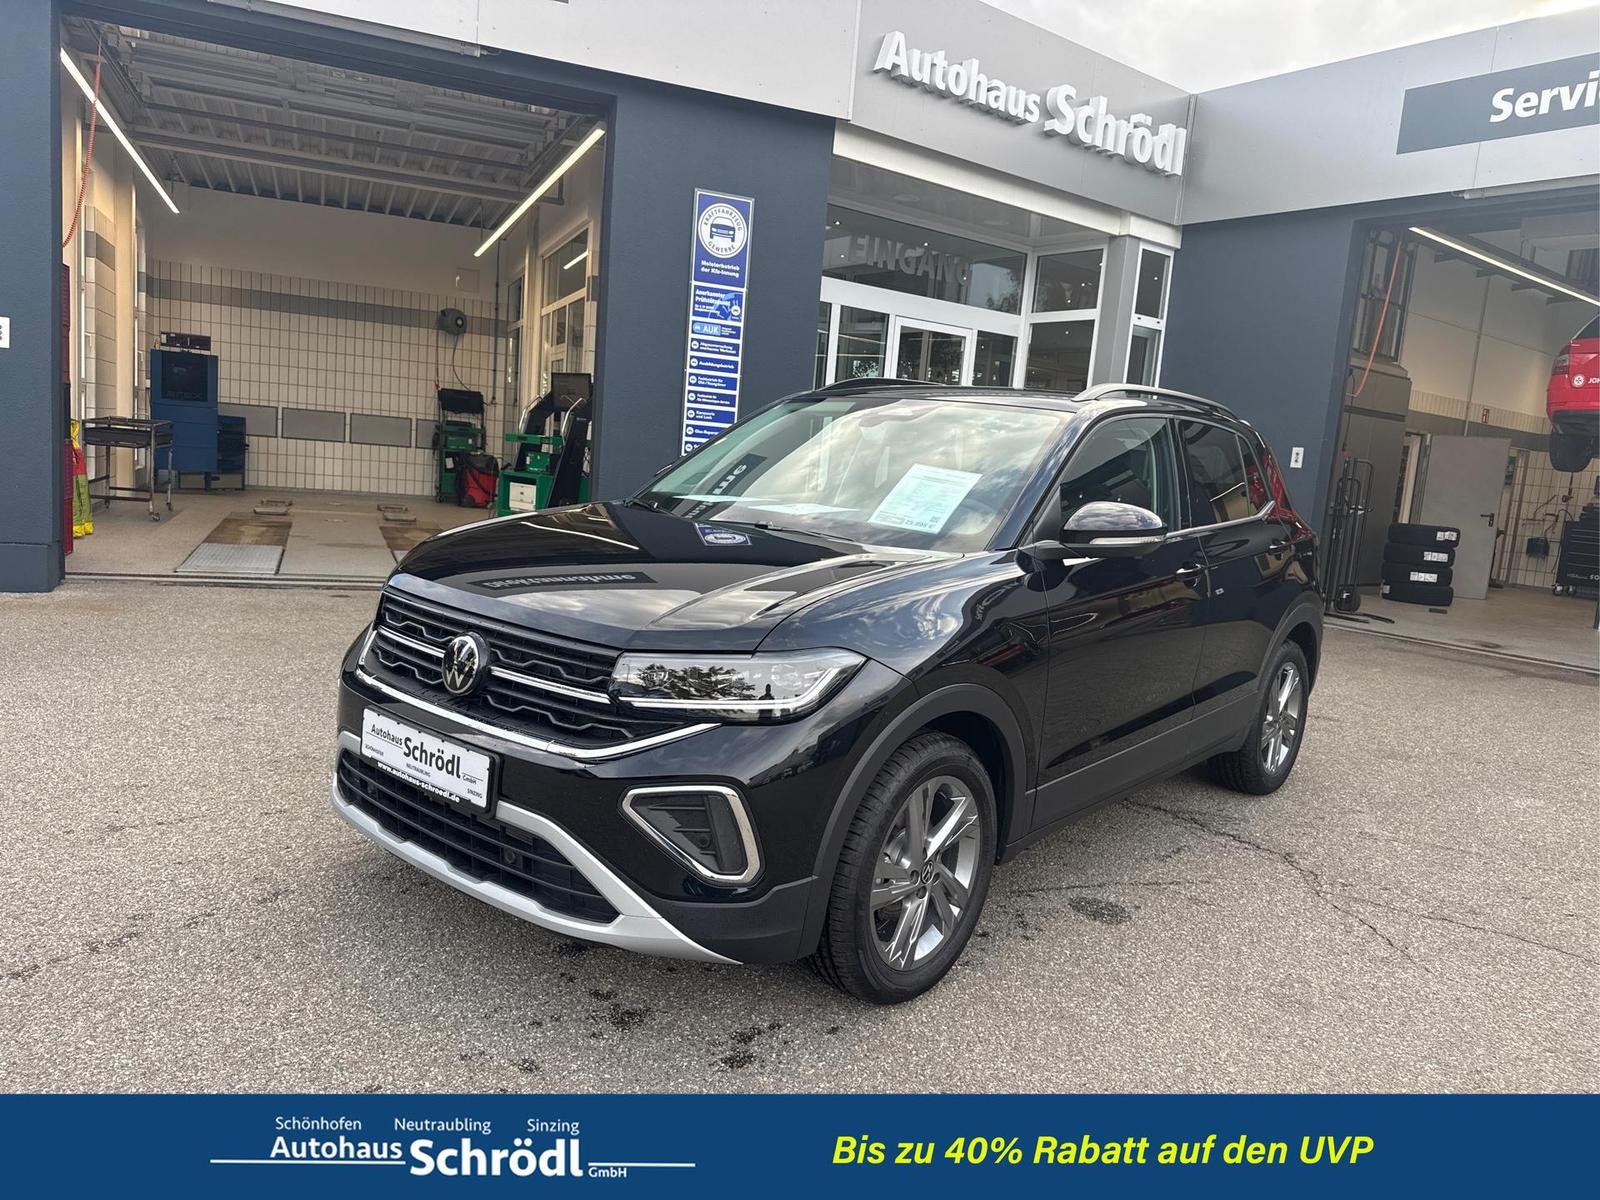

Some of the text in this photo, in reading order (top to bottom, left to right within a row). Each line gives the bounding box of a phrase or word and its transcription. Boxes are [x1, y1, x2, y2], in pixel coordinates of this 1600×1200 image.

[872, 30, 1187, 176] Autohaus Schrödl
[1489, 70, 1600, 123] Servi
[704, 208, 742, 231] KRAFTFAHRZEUG
[708, 241, 736, 253] GEWERBE
[701, 260, 740, 271] Meisterbetrieb
[371, 723, 461, 779] Autohaus Schrödl
[377, 761, 461, 803] www.autohaus-schroedl.de
[462, 774, 477, 785] GmbH
